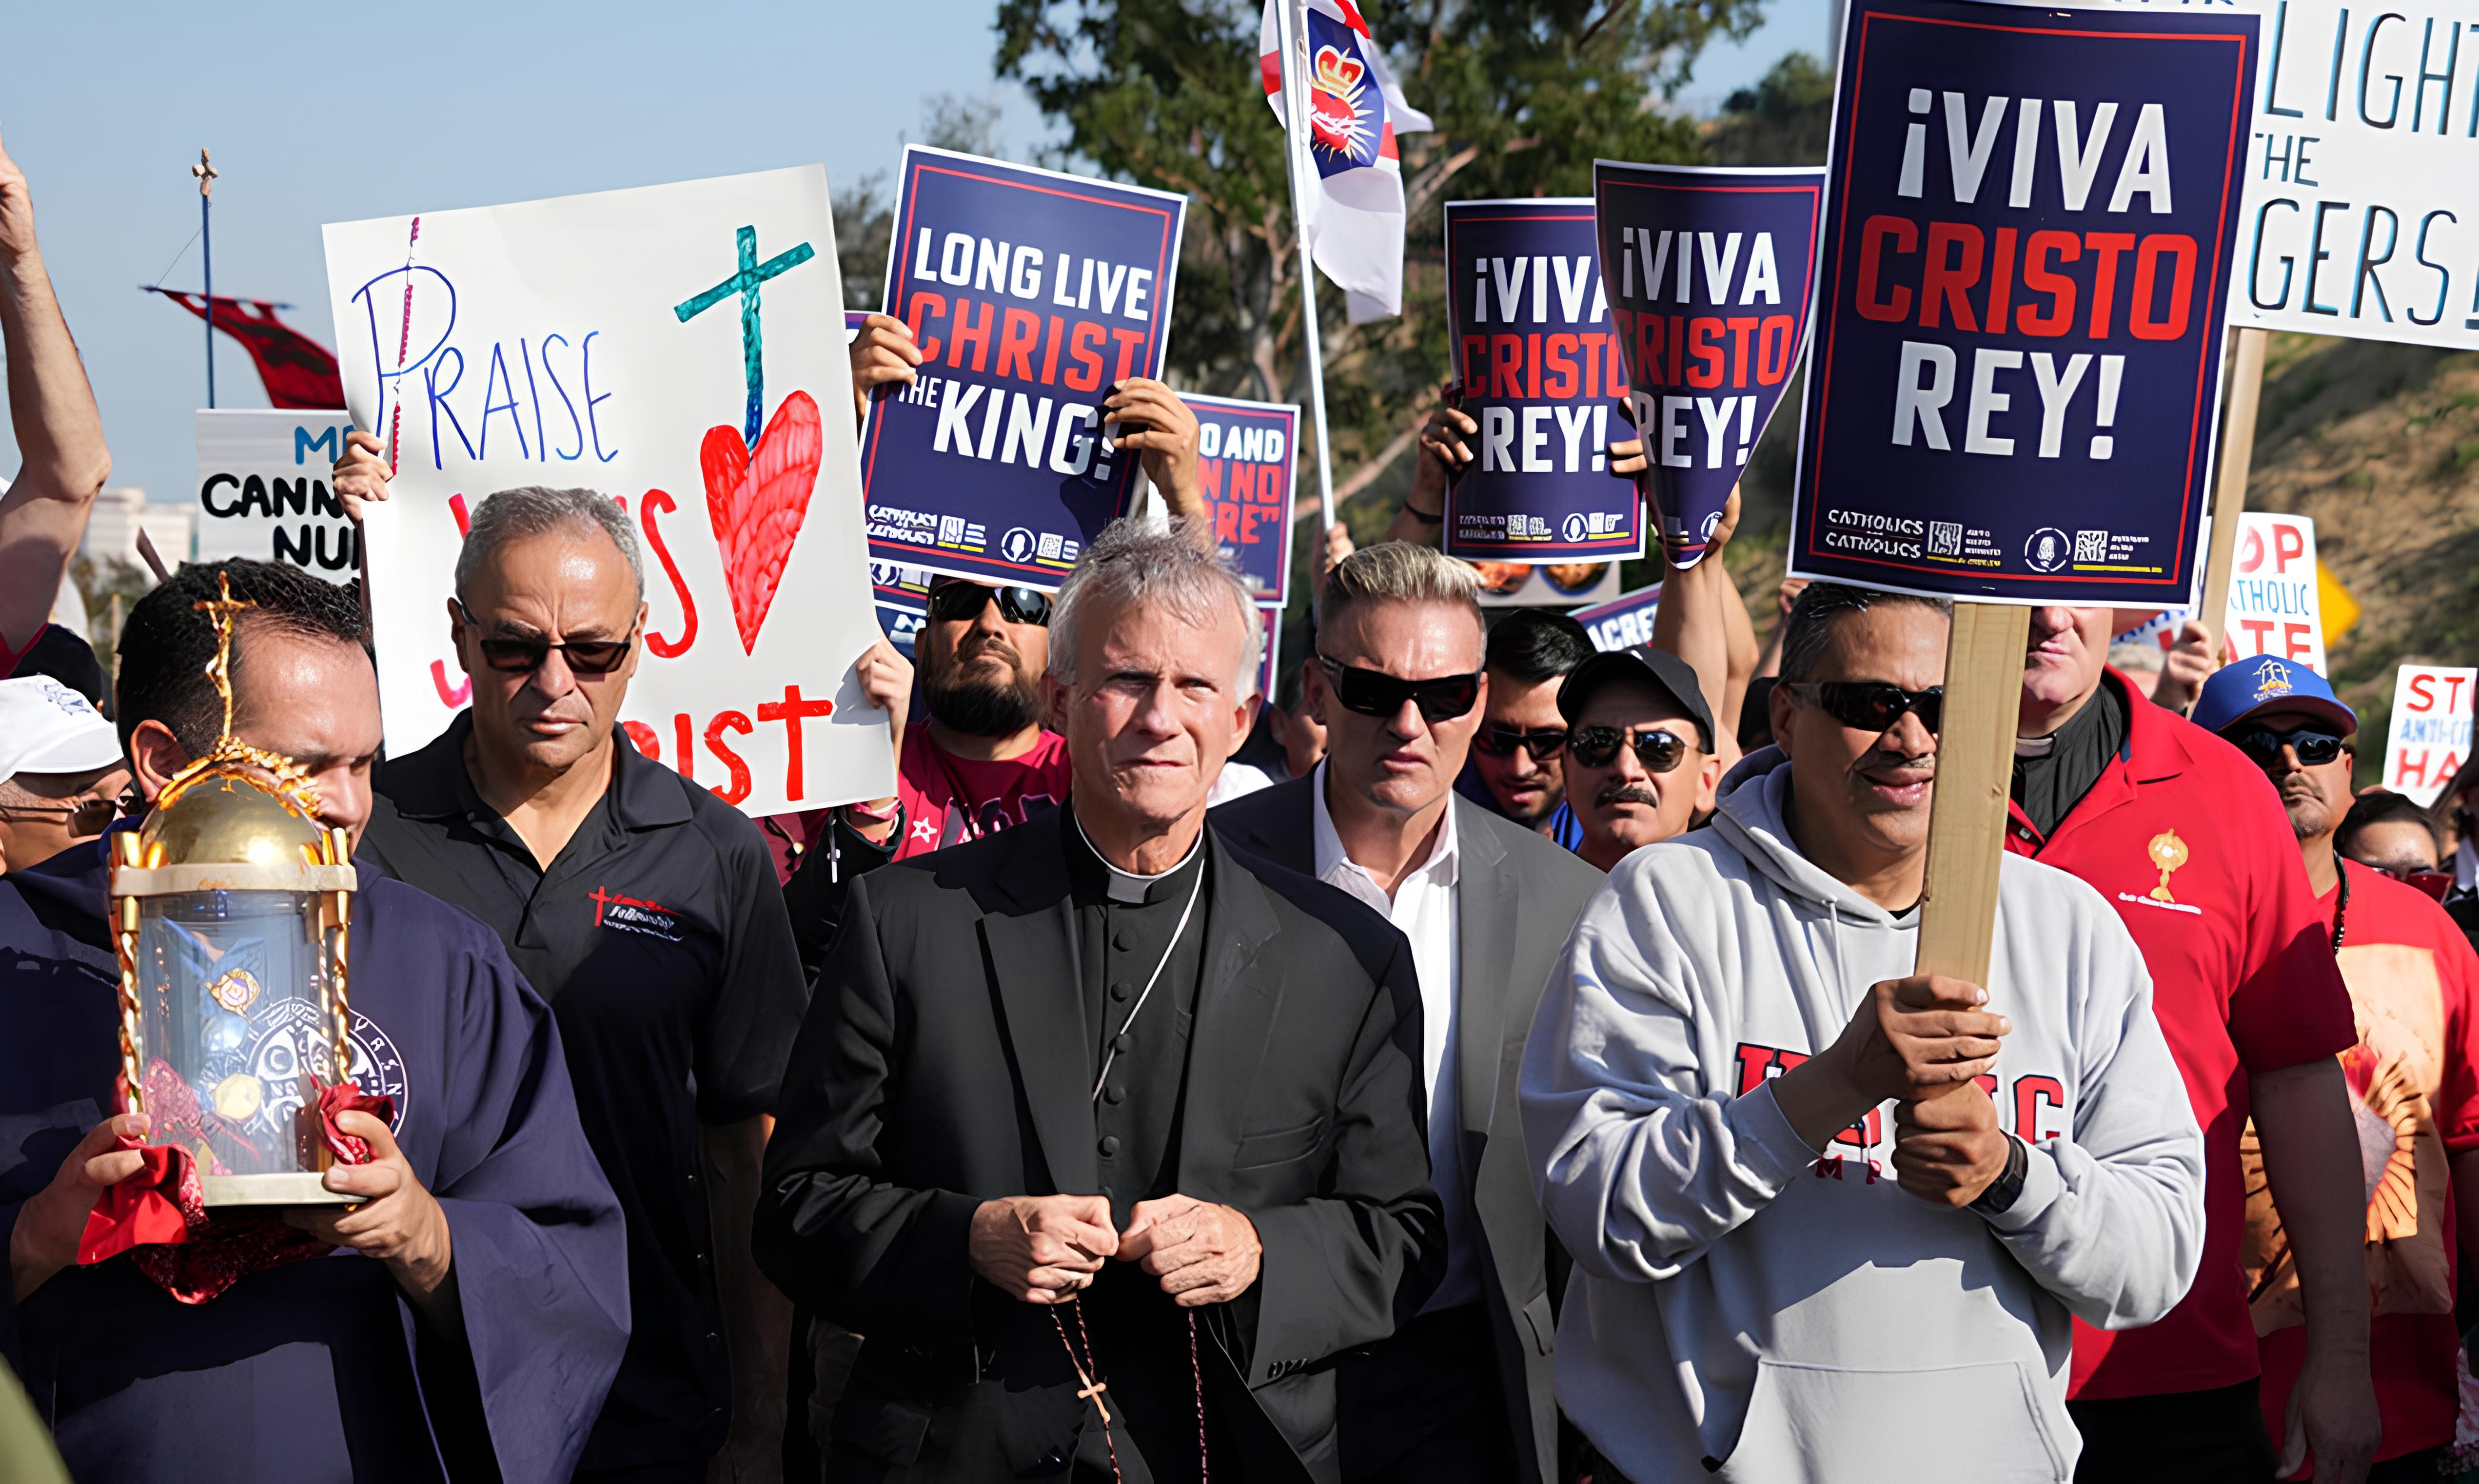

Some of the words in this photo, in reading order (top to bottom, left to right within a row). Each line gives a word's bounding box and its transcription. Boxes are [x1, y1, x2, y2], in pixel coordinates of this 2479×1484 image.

[1898, 88, 2172, 214] ¡VIVA
[2255, 133, 2321, 187] HE
[914, 227, 1043, 300] LONG
[1053, 253, 1152, 321] LIVE
[1623, 227, 1781, 305] ¡VIVA
[1855, 215, 2198, 340] CRISTO
[352, 266, 618, 469] PRAISE
[907, 292, 1145, 392] CHRIST
[933, 379, 1121, 481] KING!
[1483, 405, 1608, 472] REY!
[1632, 390, 1757, 469] REY!
[1892, 341, 2126, 460] REY!
[1223, 426, 1284, 462] AND
[1230, 461, 1281, 504] NO
[2230, 580, 2309, 616] THOLIC
[2406, 674, 2476, 714] ST
